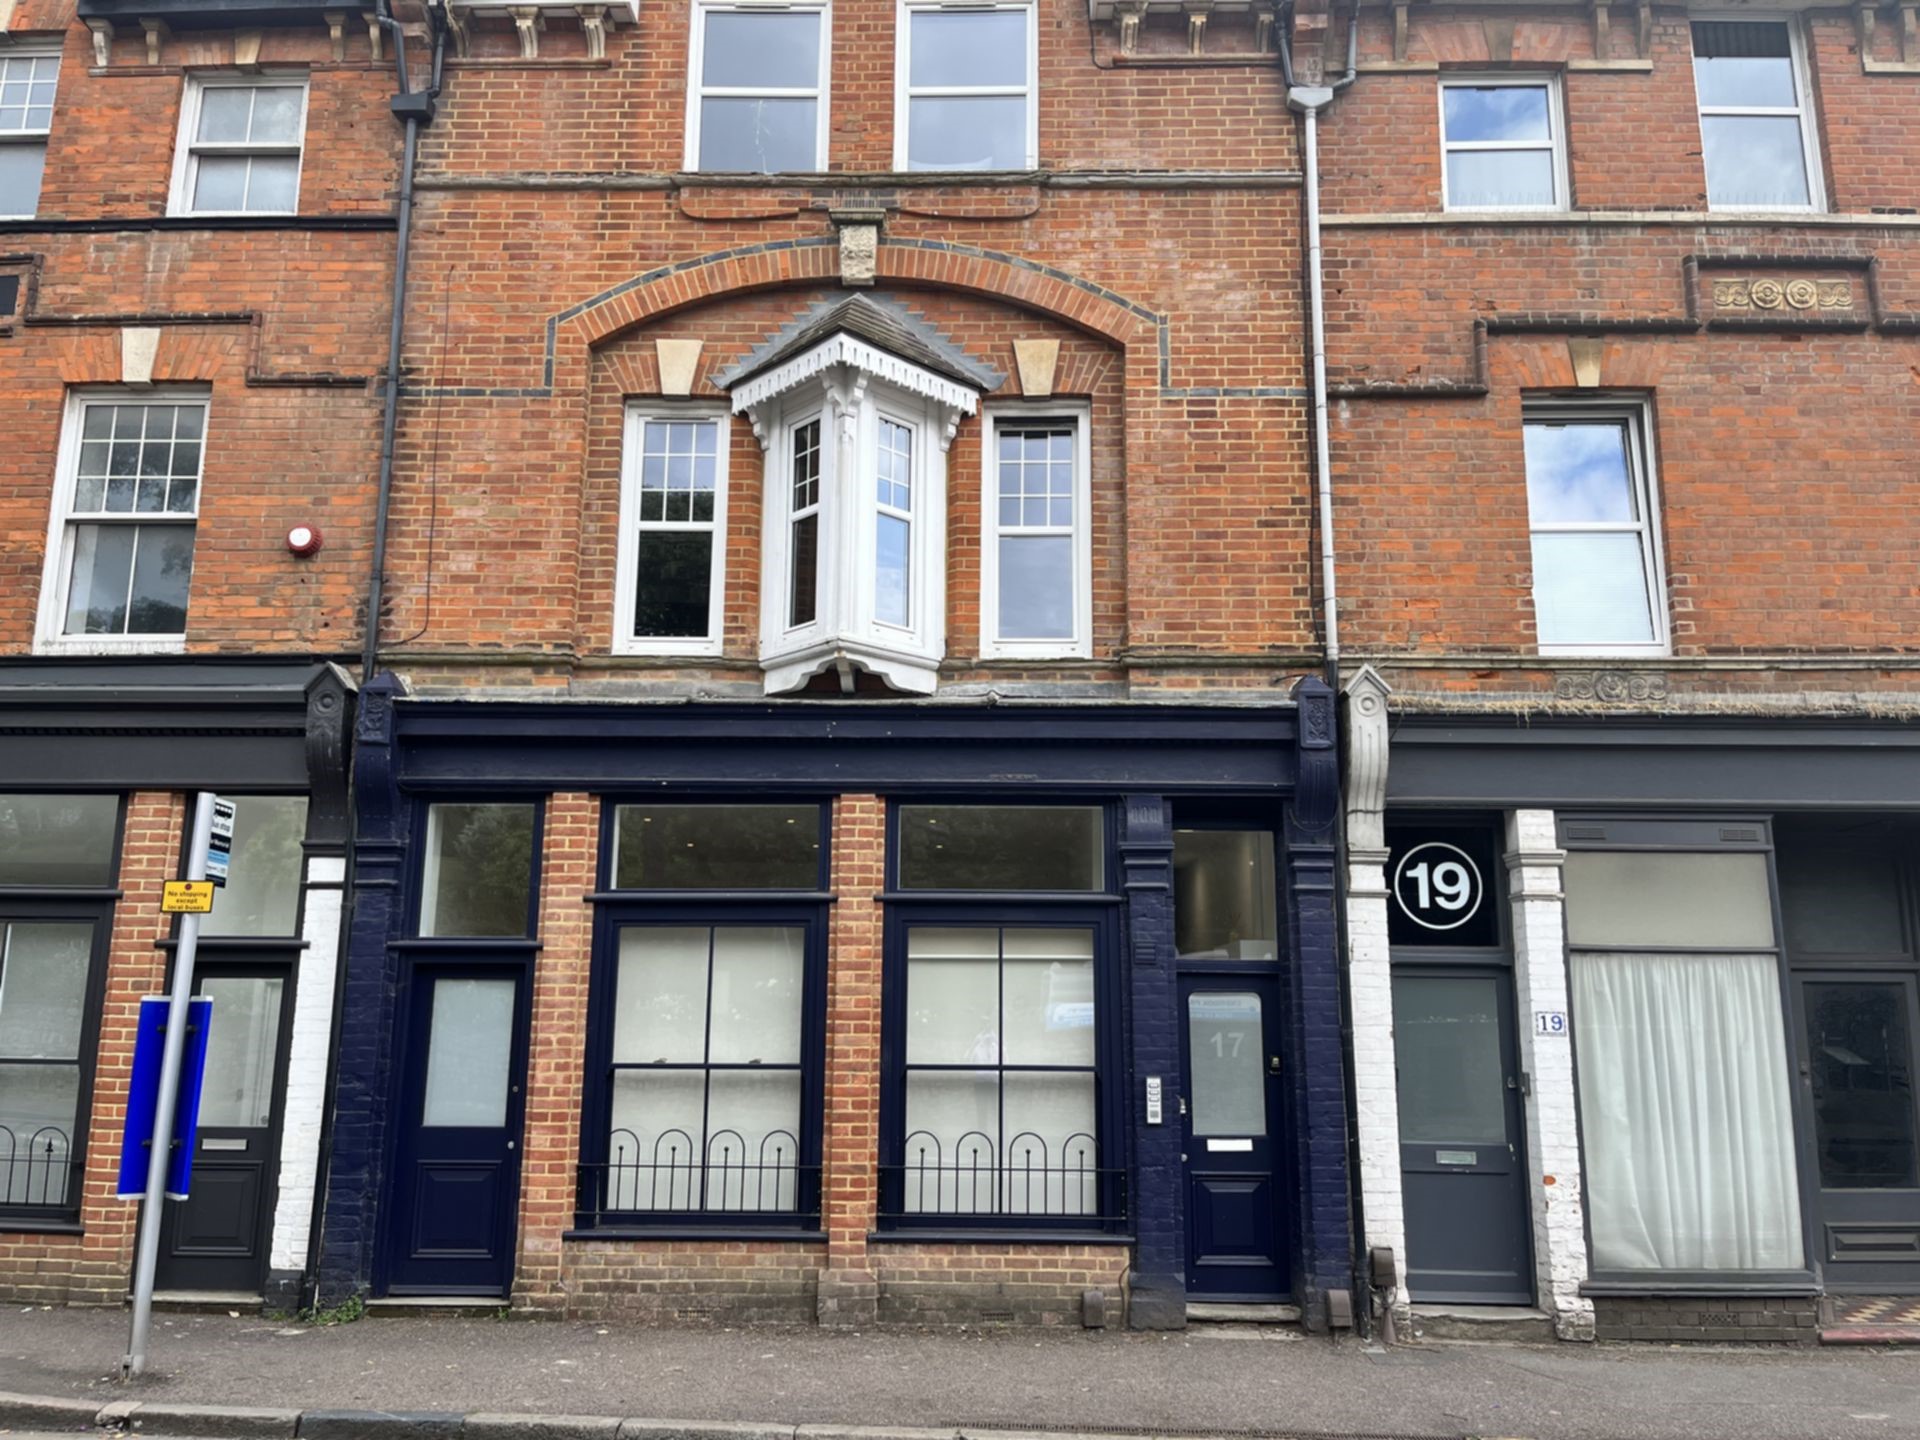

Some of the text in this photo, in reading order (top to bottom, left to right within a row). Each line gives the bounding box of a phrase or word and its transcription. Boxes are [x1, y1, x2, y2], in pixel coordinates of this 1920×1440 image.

[179, 890, 207, 898] stopping
[1406, 861, 1471, 910] 19
[1540, 1015, 1563, 1031] 19
[1210, 1032, 1245, 1058] 17
